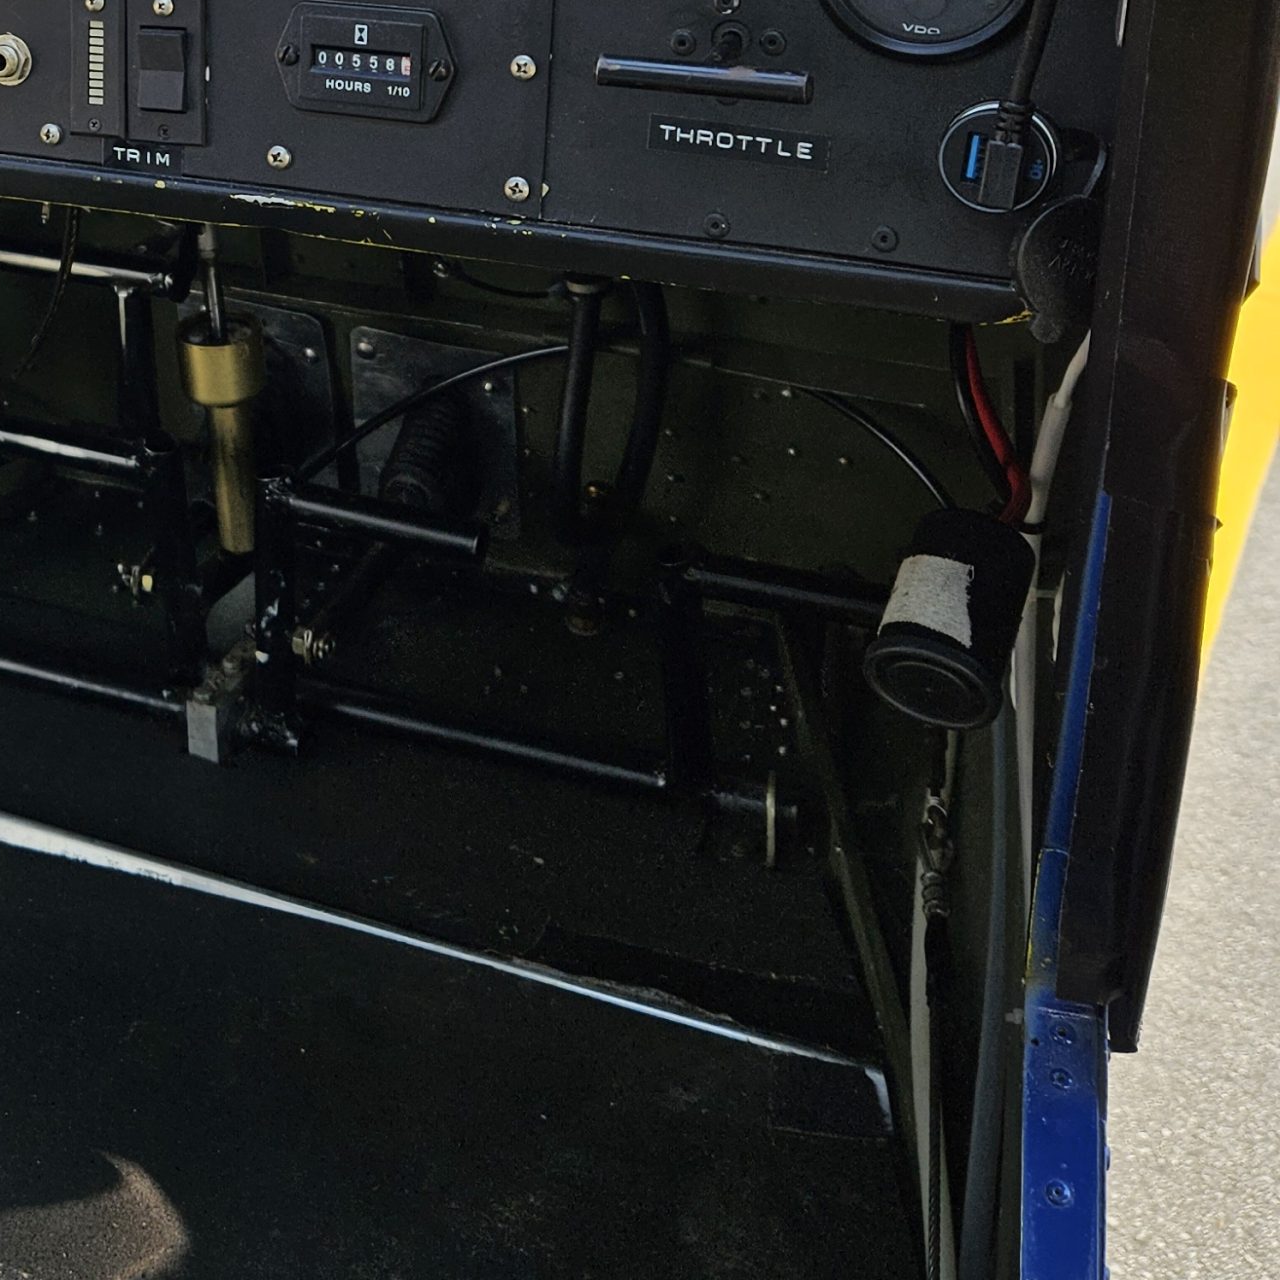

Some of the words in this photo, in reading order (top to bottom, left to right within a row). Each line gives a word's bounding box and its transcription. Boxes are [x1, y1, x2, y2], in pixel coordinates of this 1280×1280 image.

[325, 79, 371, 93] HOURS
[387, 86, 410, 97] 1/10
[659, 123, 814, 160] THROTTLE
[113, 146, 170, 167] TRIM
